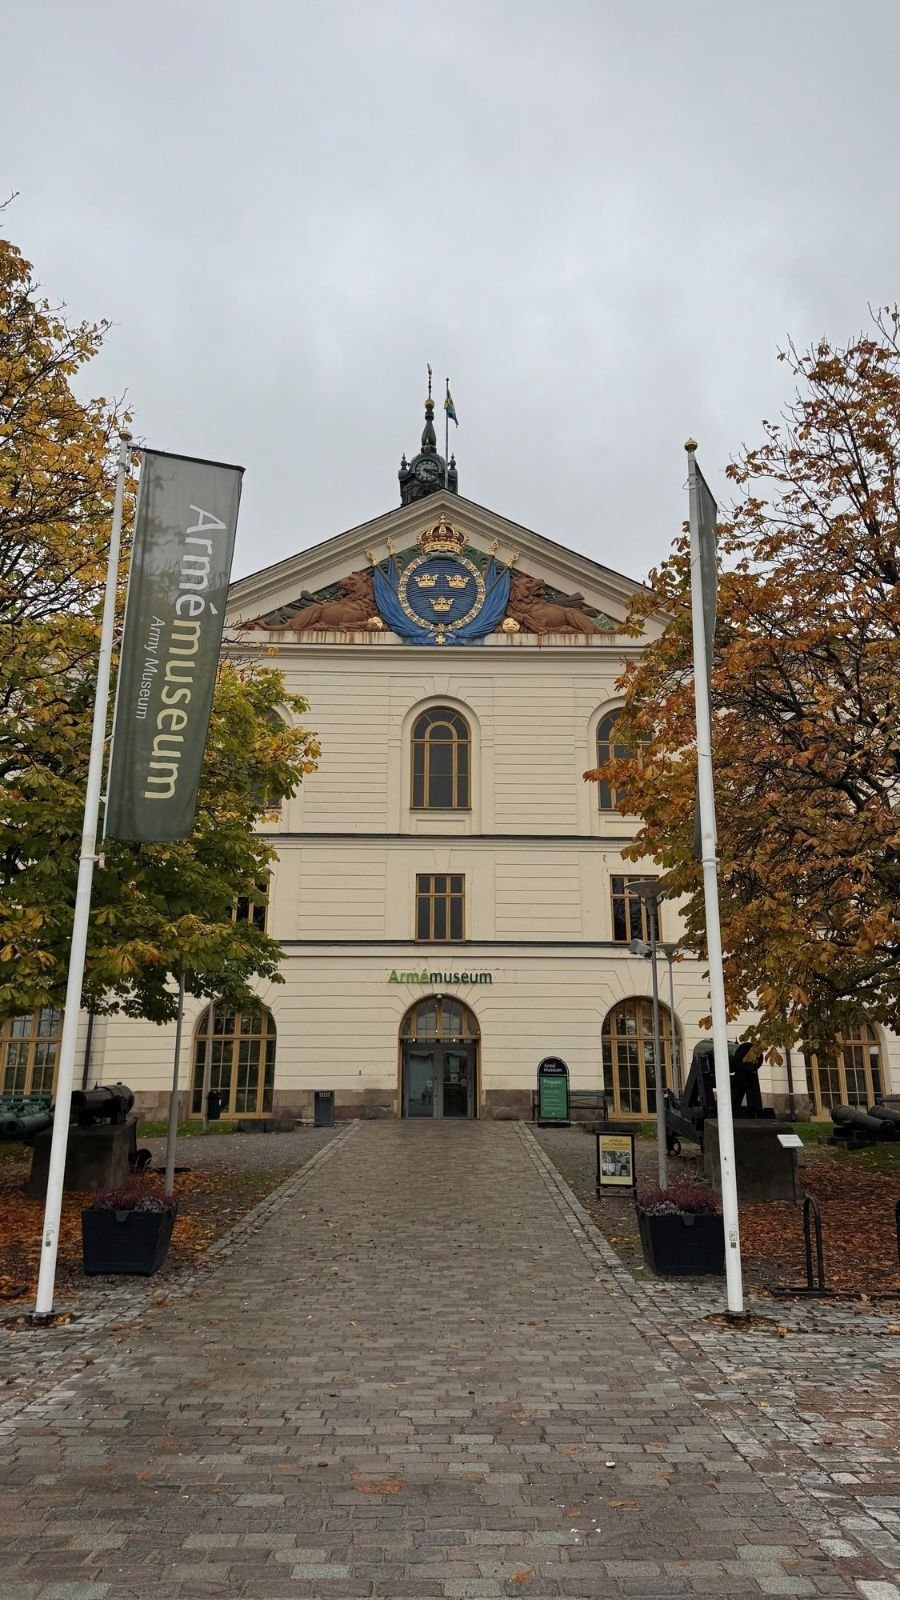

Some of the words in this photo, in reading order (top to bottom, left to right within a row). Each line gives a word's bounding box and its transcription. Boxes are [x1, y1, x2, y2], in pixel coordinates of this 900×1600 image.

[143, 615, 166, 654] Army
[144, 504, 227, 799] Armémuseum
[135, 657, 159, 720] Museum
[388, 968, 493, 984] Armémuseum
